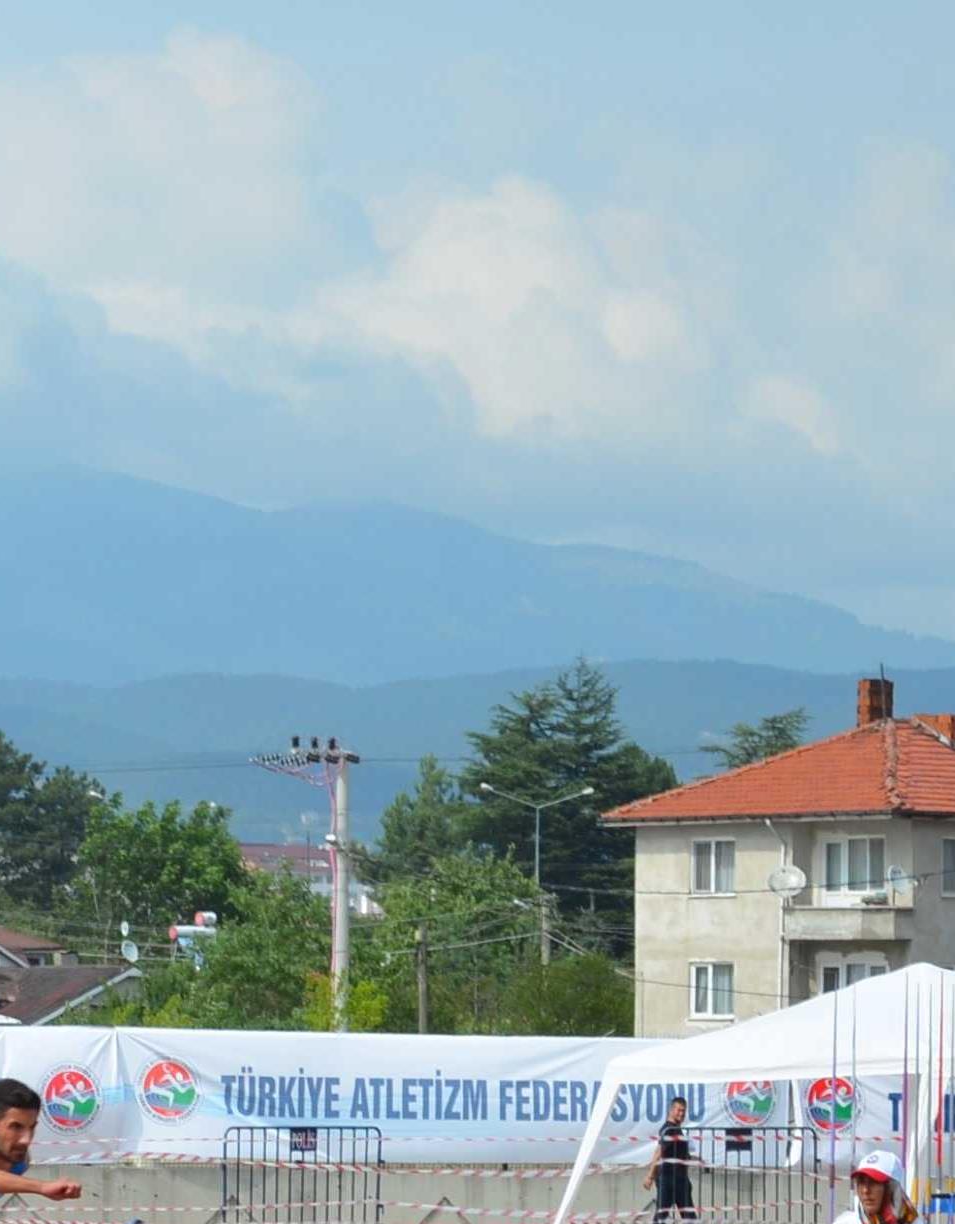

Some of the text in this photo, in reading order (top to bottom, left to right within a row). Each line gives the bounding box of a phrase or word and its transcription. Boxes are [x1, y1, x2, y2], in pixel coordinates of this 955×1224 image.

[221, 1067, 340, 1119] TÜRKİYE
[350, 1070, 487, 1120] ATLETİZM
[500, 1080, 705, 1122] FEDERSYOU
